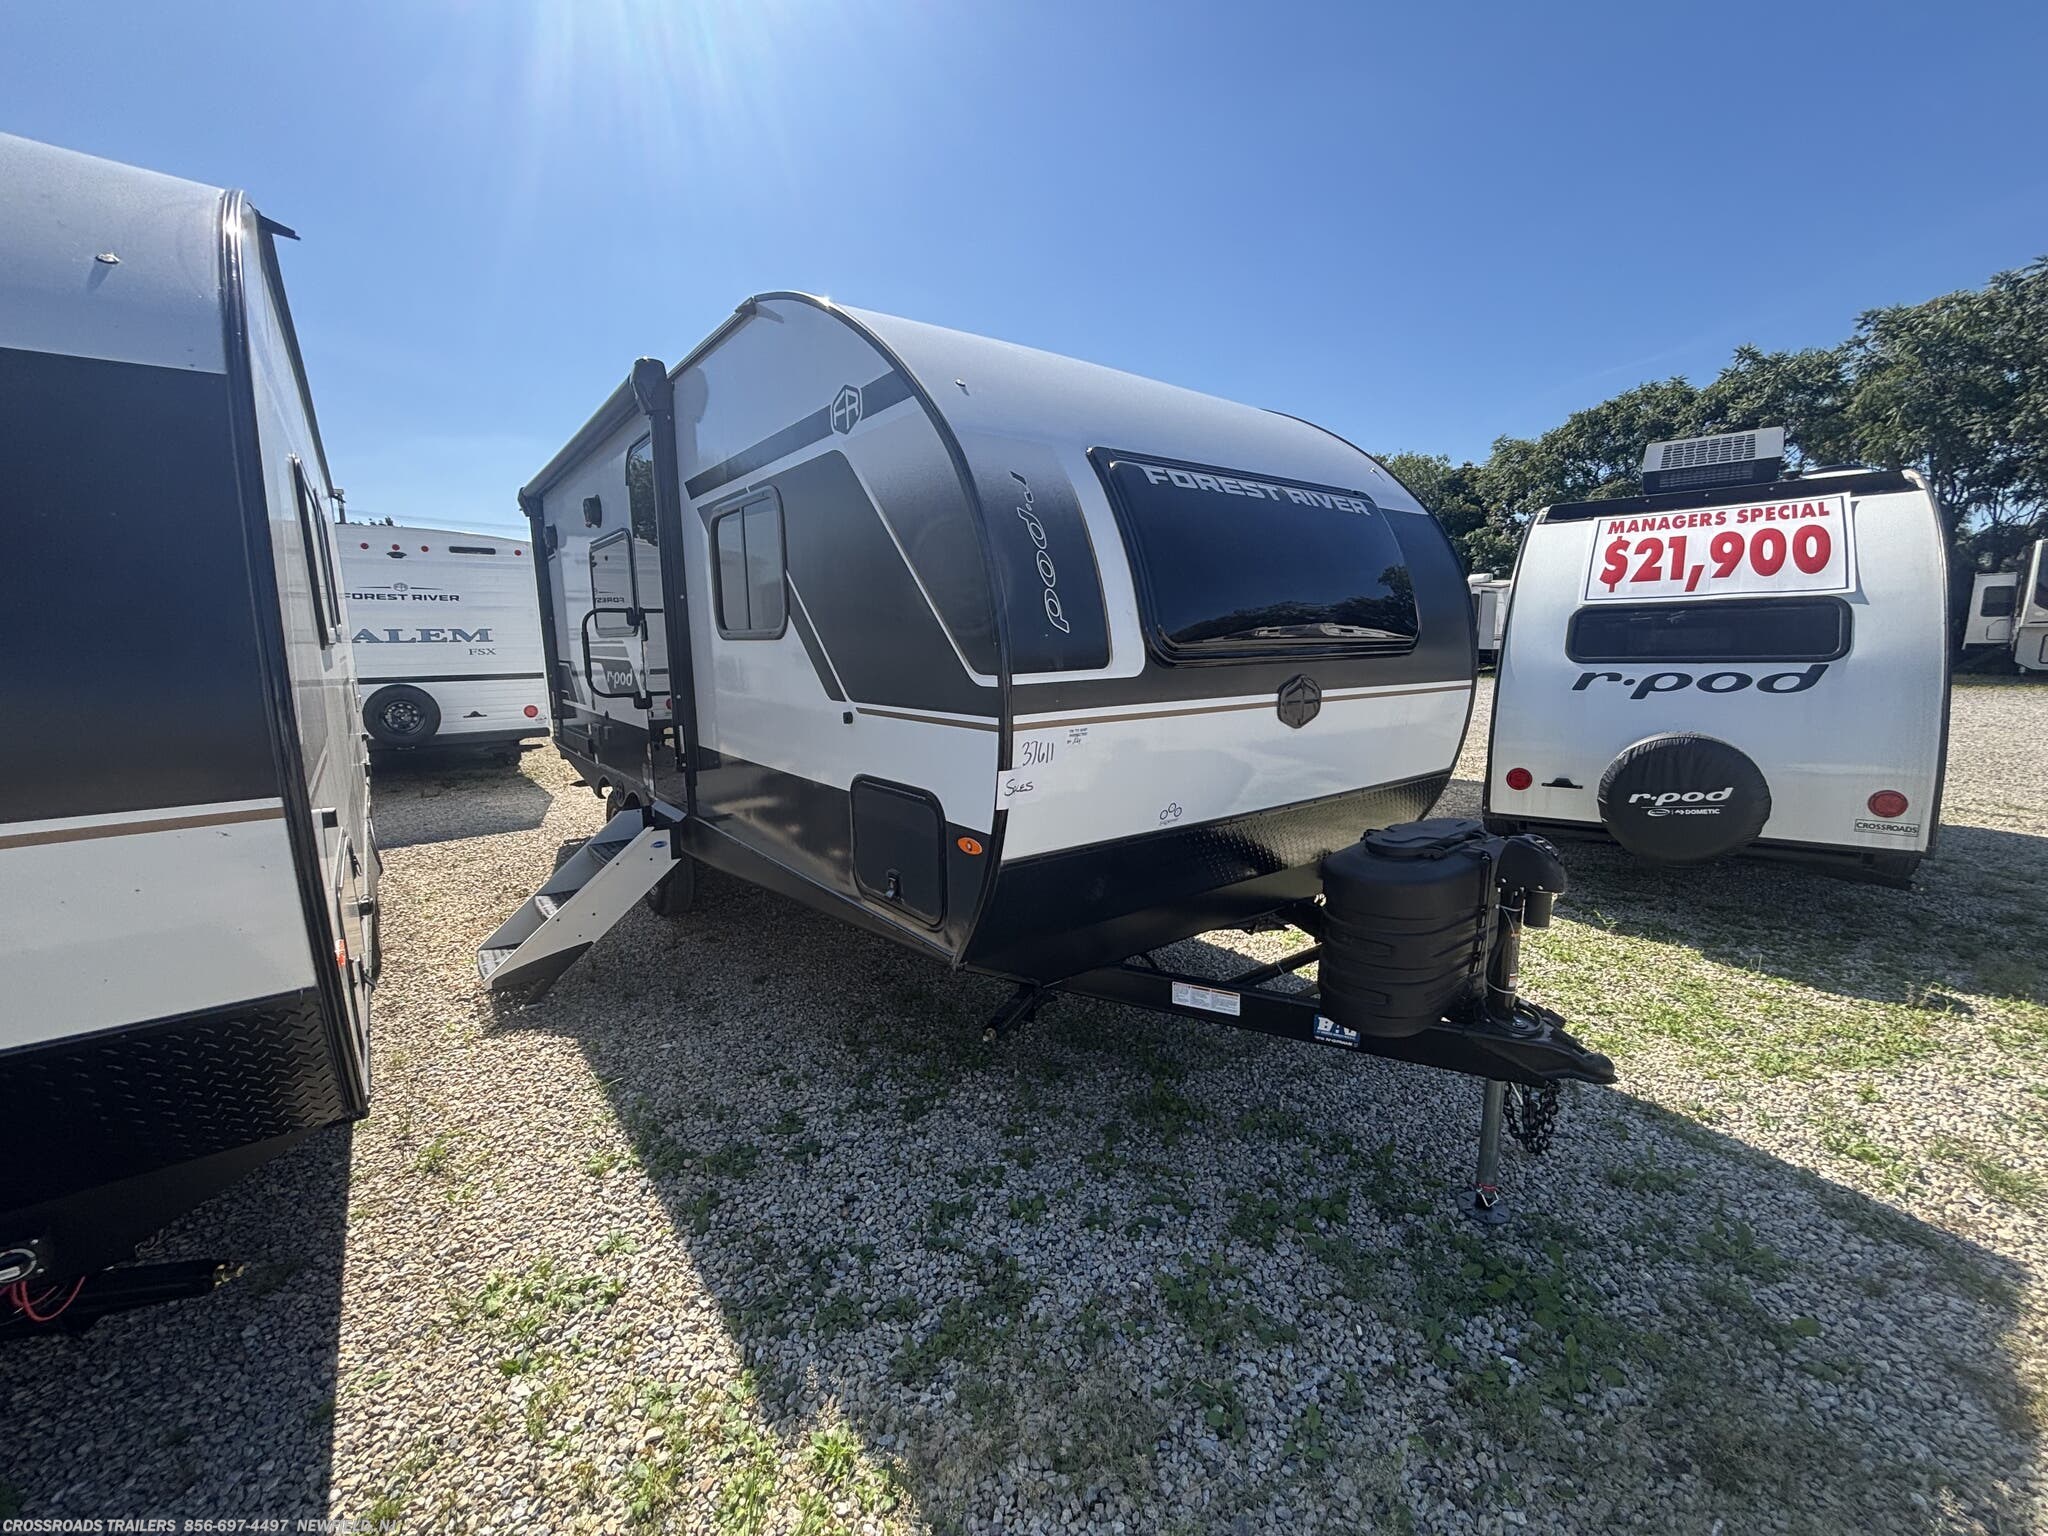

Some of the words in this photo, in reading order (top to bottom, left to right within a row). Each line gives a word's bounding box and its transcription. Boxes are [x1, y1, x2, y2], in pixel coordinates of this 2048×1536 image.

[1142, 466, 1280, 502] FOREST
[1284, 488, 1371, 516] RIVER
[1607, 511, 1727, 535] MANAGERS
[1736, 501, 1830, 523] SPECIAL
[1599, 523, 1832, 592] $21,900
[412, 594, 460, 602] RIVER
[352, 628, 494, 644] ALEM
[468, 648, 497, 656] FSX
[1022, 740, 1054, 766] 37611
[1856, 822, 1917, 833] CROSSROADS
